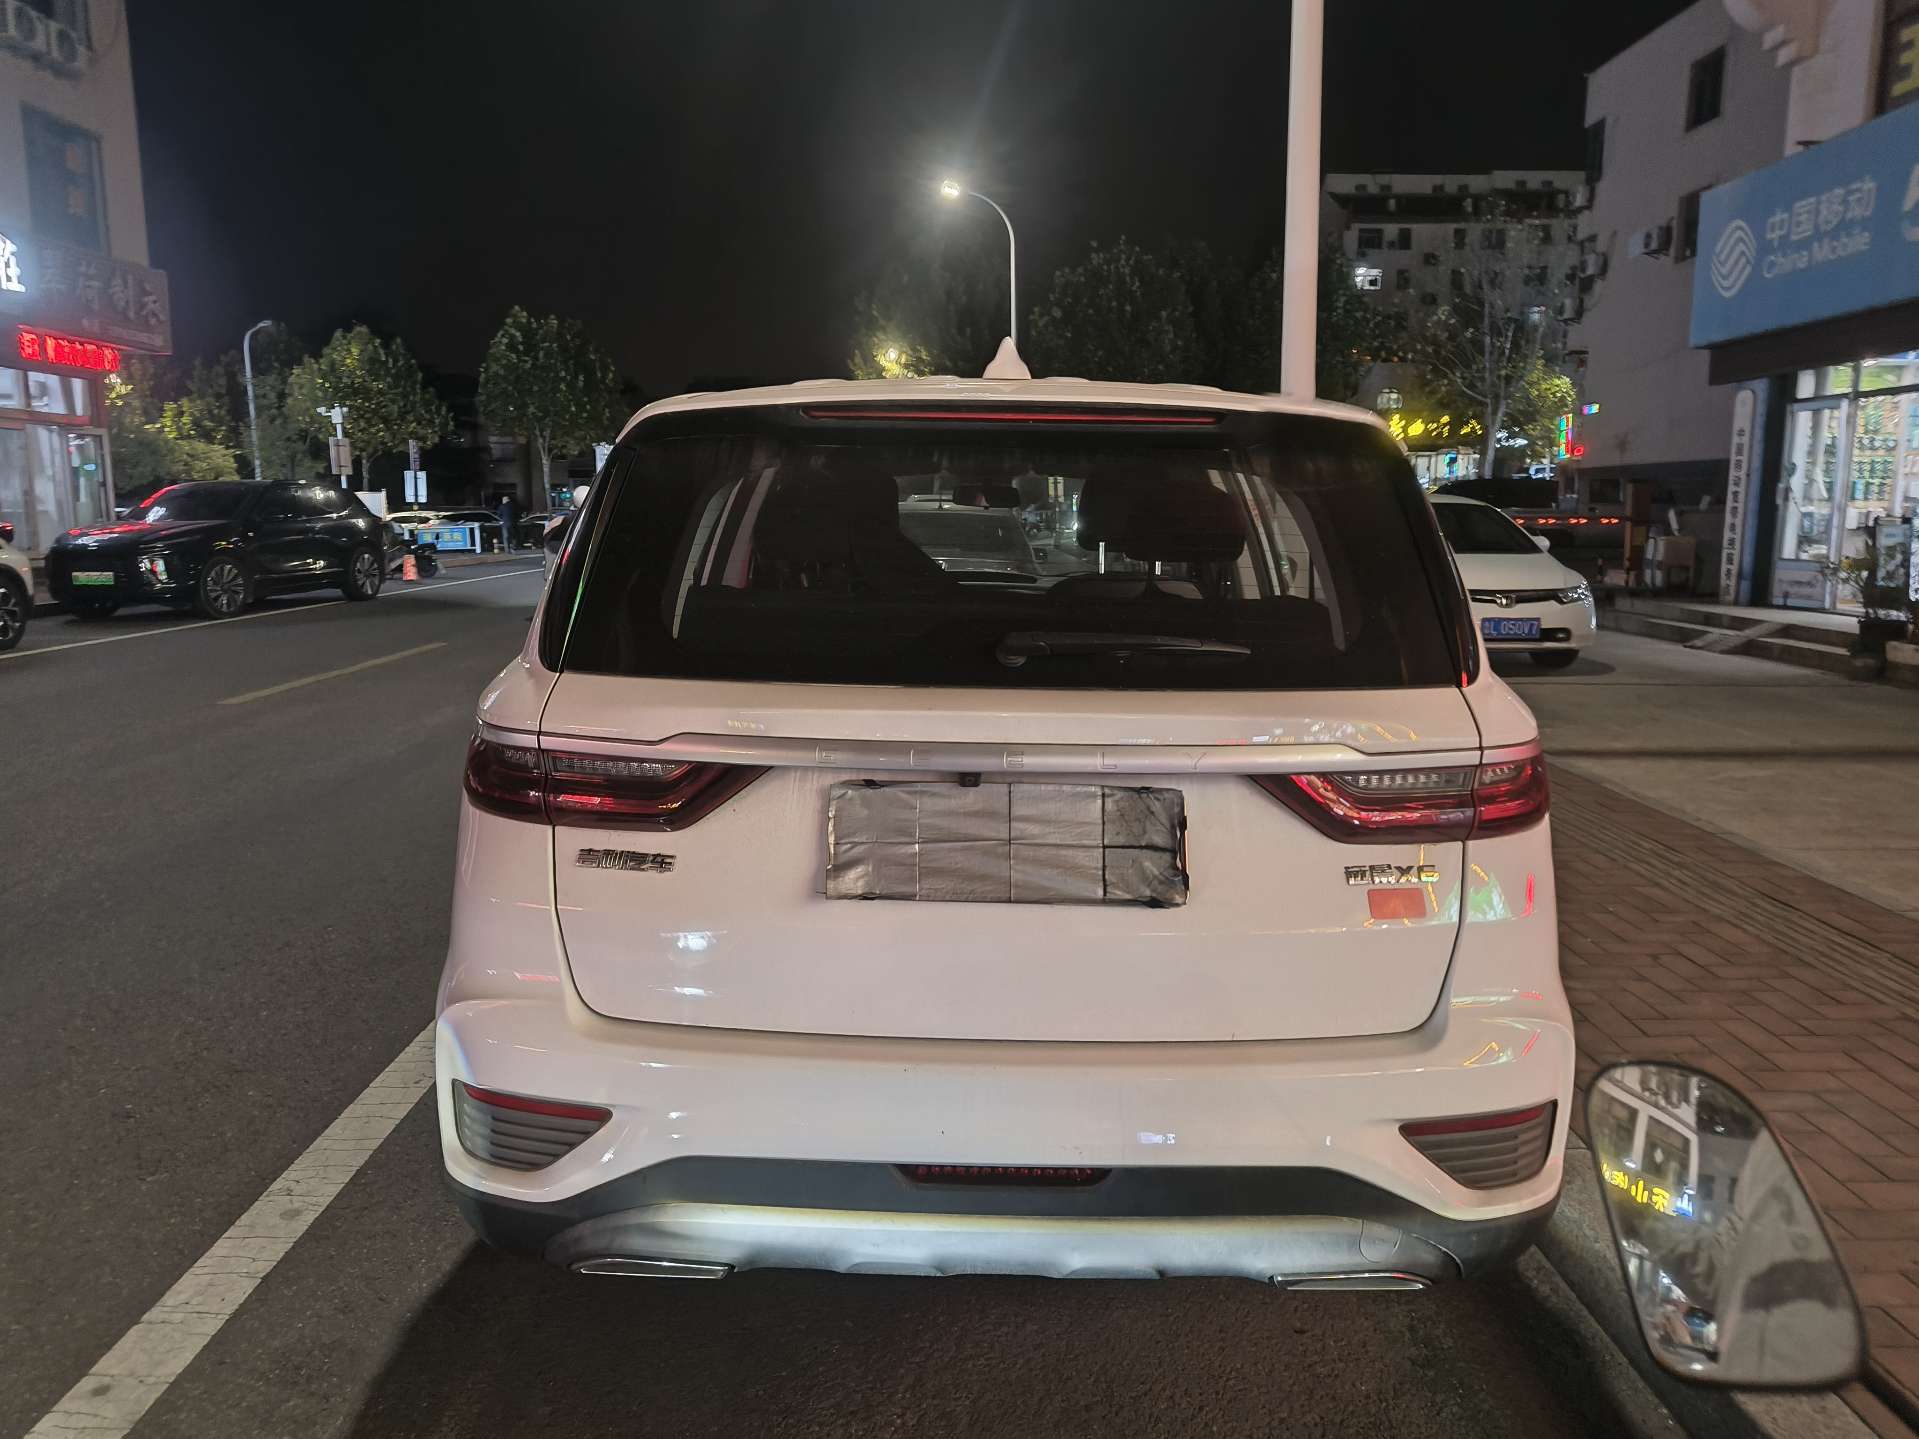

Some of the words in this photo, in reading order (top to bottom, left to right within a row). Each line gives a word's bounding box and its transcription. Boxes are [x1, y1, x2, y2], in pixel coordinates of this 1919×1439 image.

[1766, 174, 1878, 248] 中国移动
[1762, 250, 1810, 278] China
[1811, 228, 1873, 265] Mobile
[815, 743, 1207, 771] GEELY
